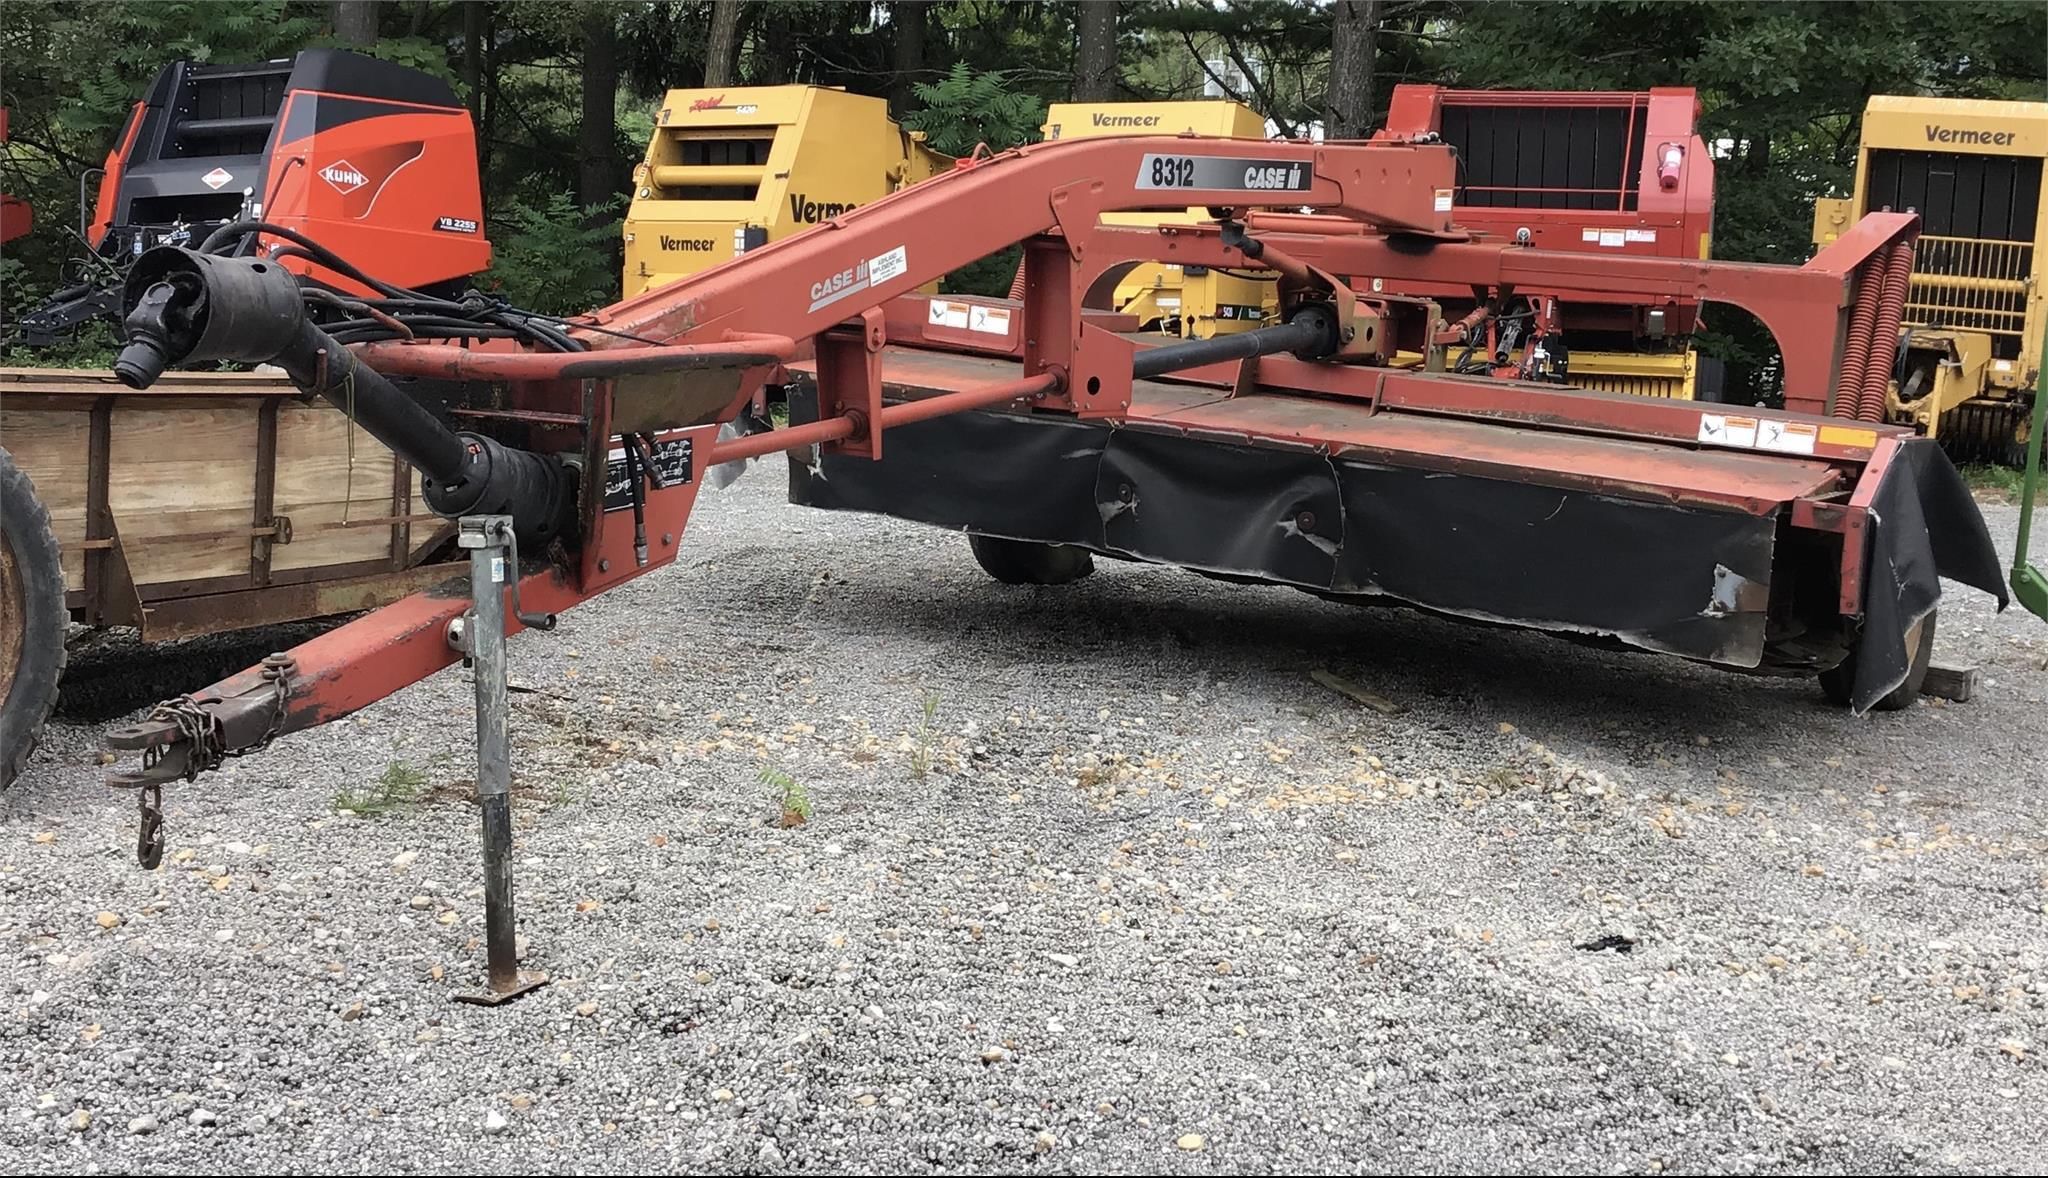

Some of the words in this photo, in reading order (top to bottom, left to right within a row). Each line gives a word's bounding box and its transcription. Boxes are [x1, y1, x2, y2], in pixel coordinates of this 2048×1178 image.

[1092, 113, 1160, 126] Vermeer
[1925, 124, 2016, 146] Vermeer
[326, 168, 362, 186] KUHN
[1151, 157, 1194, 187] 8312
[1244, 166, 1287, 189] CASE
[790, 193, 866, 224] Verm
[440, 216, 453, 226] VB
[454, 219, 476, 229] 2255
[660, 235, 715, 252] Vermeer
[811, 268, 853, 300] CASE
